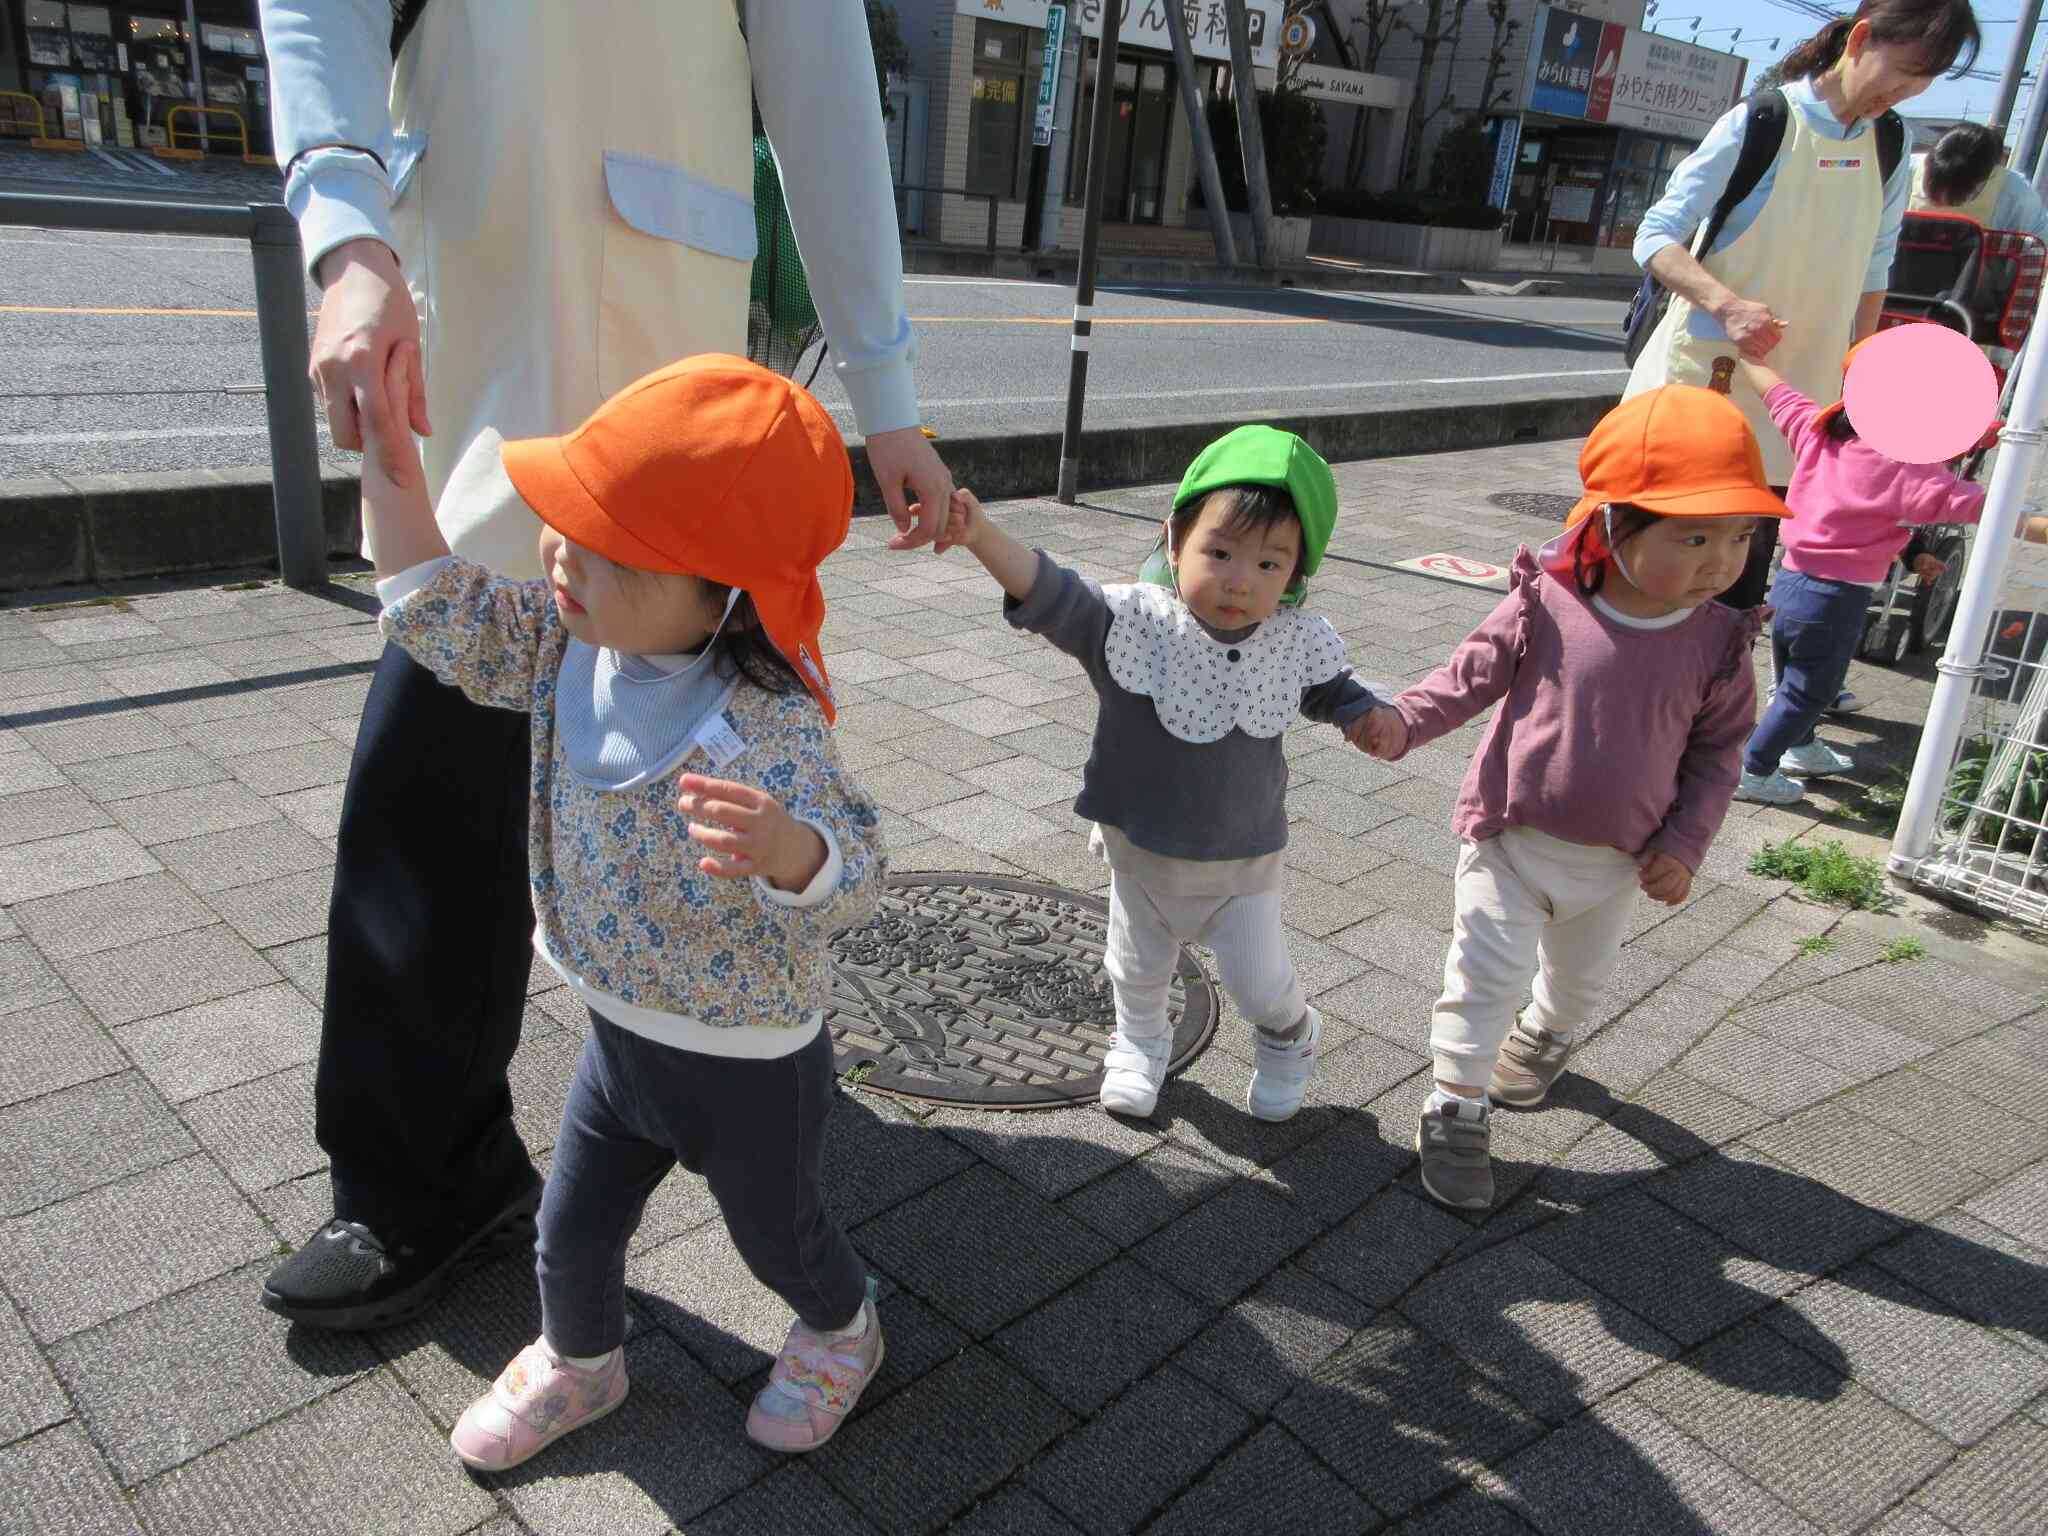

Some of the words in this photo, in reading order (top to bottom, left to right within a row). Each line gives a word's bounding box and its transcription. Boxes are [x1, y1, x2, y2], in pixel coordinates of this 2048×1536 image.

[1329, 79, 1364, 96] SAYAMA
[1616, 73, 1730, 115] みやた内科クリニック
